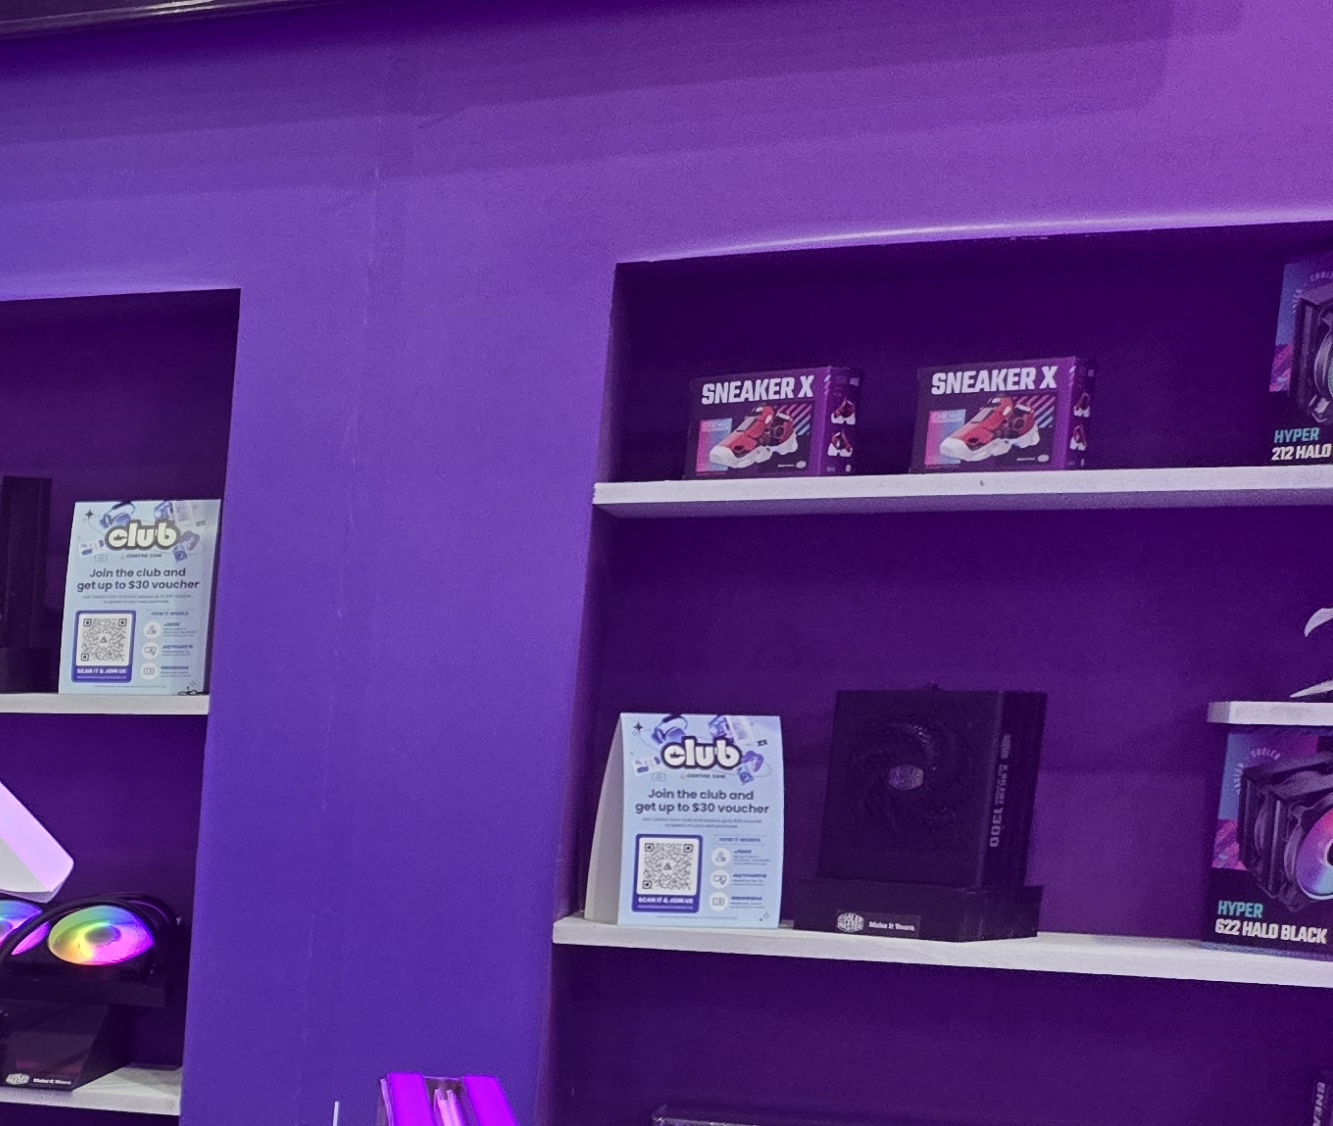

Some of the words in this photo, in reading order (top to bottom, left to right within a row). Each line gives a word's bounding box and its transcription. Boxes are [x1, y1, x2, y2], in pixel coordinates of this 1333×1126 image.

[931, 367, 1036, 395] SNEAKER
[1039, 366, 1058, 389] X
[701, 377, 795, 405] SNEAKER
[797, 375, 814, 398] X
[1273, 428, 1320, 444] HYPER
[1271, 446, 1294, 461] 212
[1295, 443, 1331, 460] HALO
[106, 520, 180, 550] club
[89, 568, 114, 578] Join
[116, 568, 134, 578] the
[136, 568, 161, 577] club
[163, 567, 186, 577] and
[77, 580, 95, 592] get
[97, 582, 114, 592] up
[115, 581, 126, 590] to
[128, 580, 150, 590] $30
[152, 579, 200, 590] voucher
[662, 737, 741, 769] club
[648, 788, 674, 799] Join
[677, 789, 697, 800] the
[699, 789, 727, 800] club
[729, 790, 754, 800] and
[635, 803, 656, 814] get
[658, 804, 675, 814] up
[678, 802, 690, 812] to
[692, 802, 715, 813] $30
[718, 803, 770, 813] voucher
[1217, 900, 1264, 918] HYPER
[1215, 918, 1240, 936] 622
[1242, 921, 1278, 940] HALO
[1280, 925, 1328, 944] BLACK
